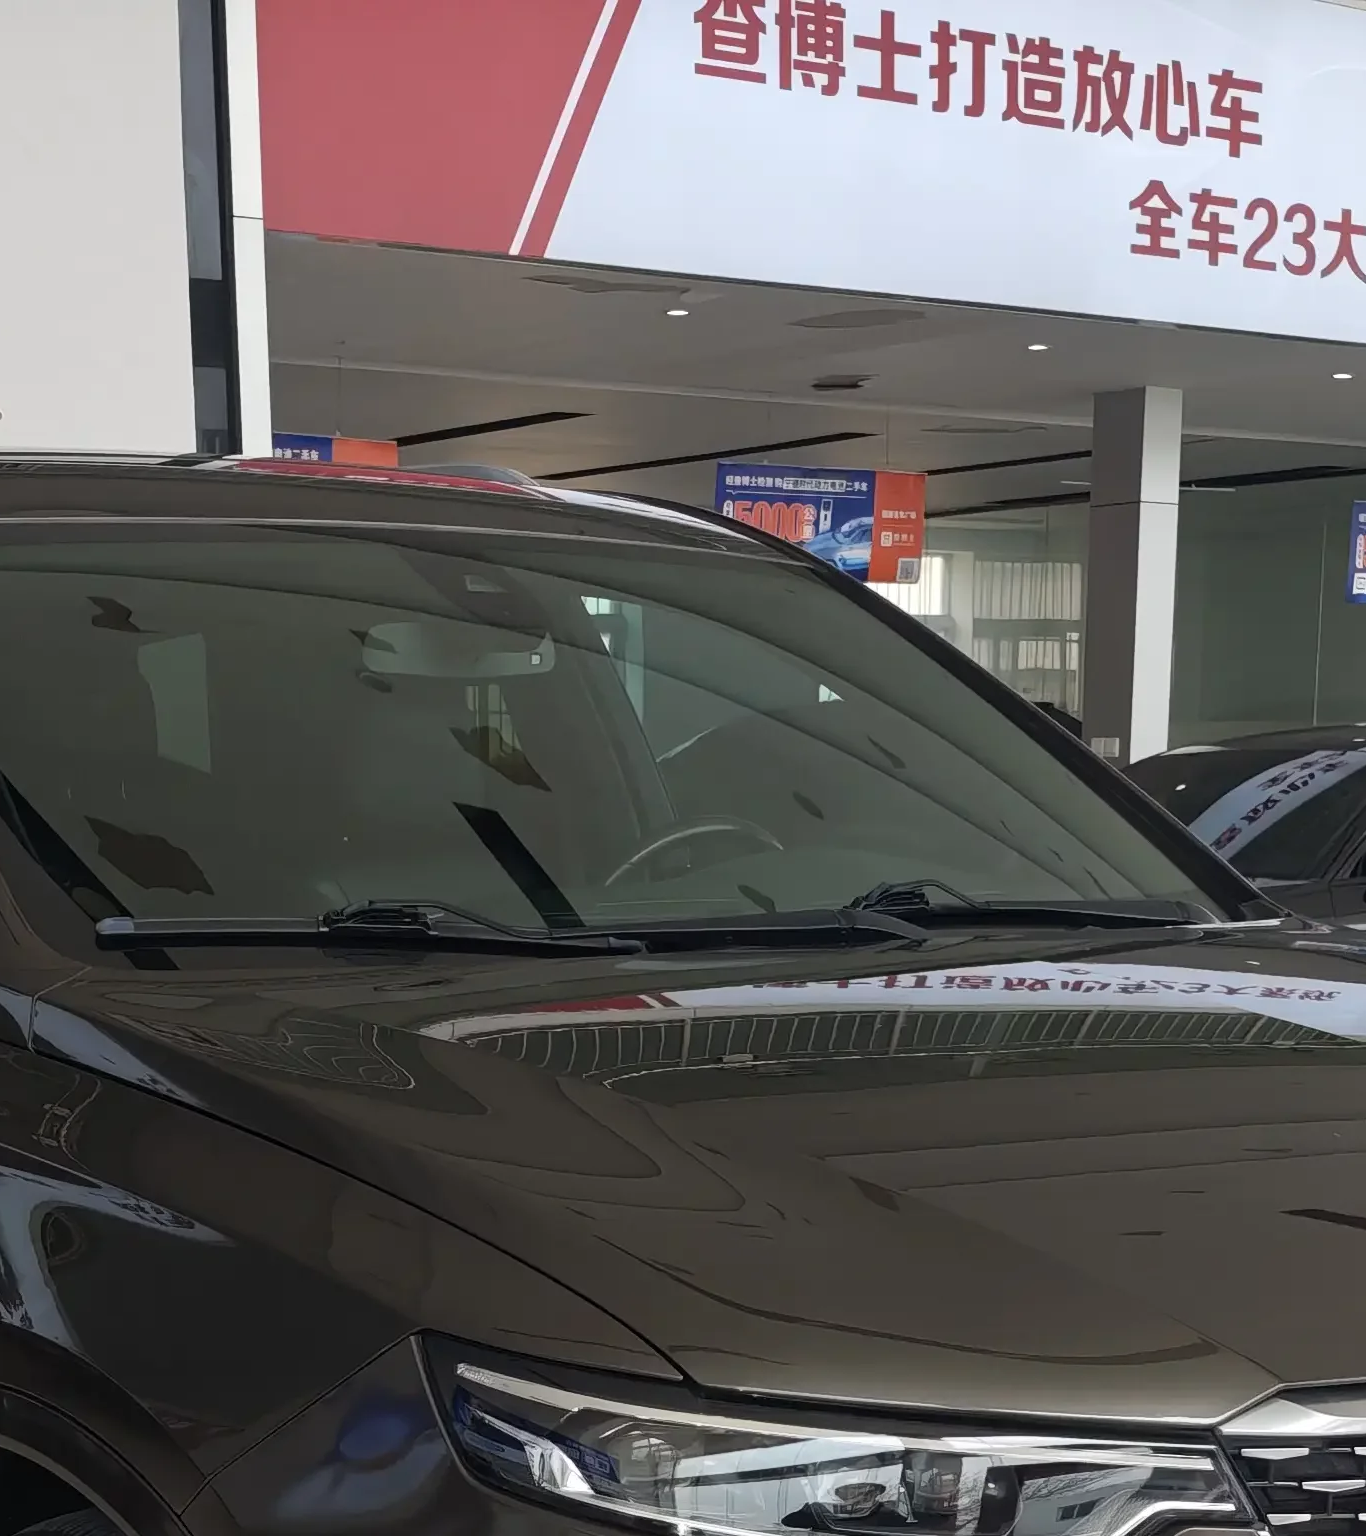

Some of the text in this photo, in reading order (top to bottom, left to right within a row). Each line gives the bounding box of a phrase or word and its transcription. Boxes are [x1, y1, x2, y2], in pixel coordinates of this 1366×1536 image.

[693, 0, 1265, 159] 查博士打造放心车
